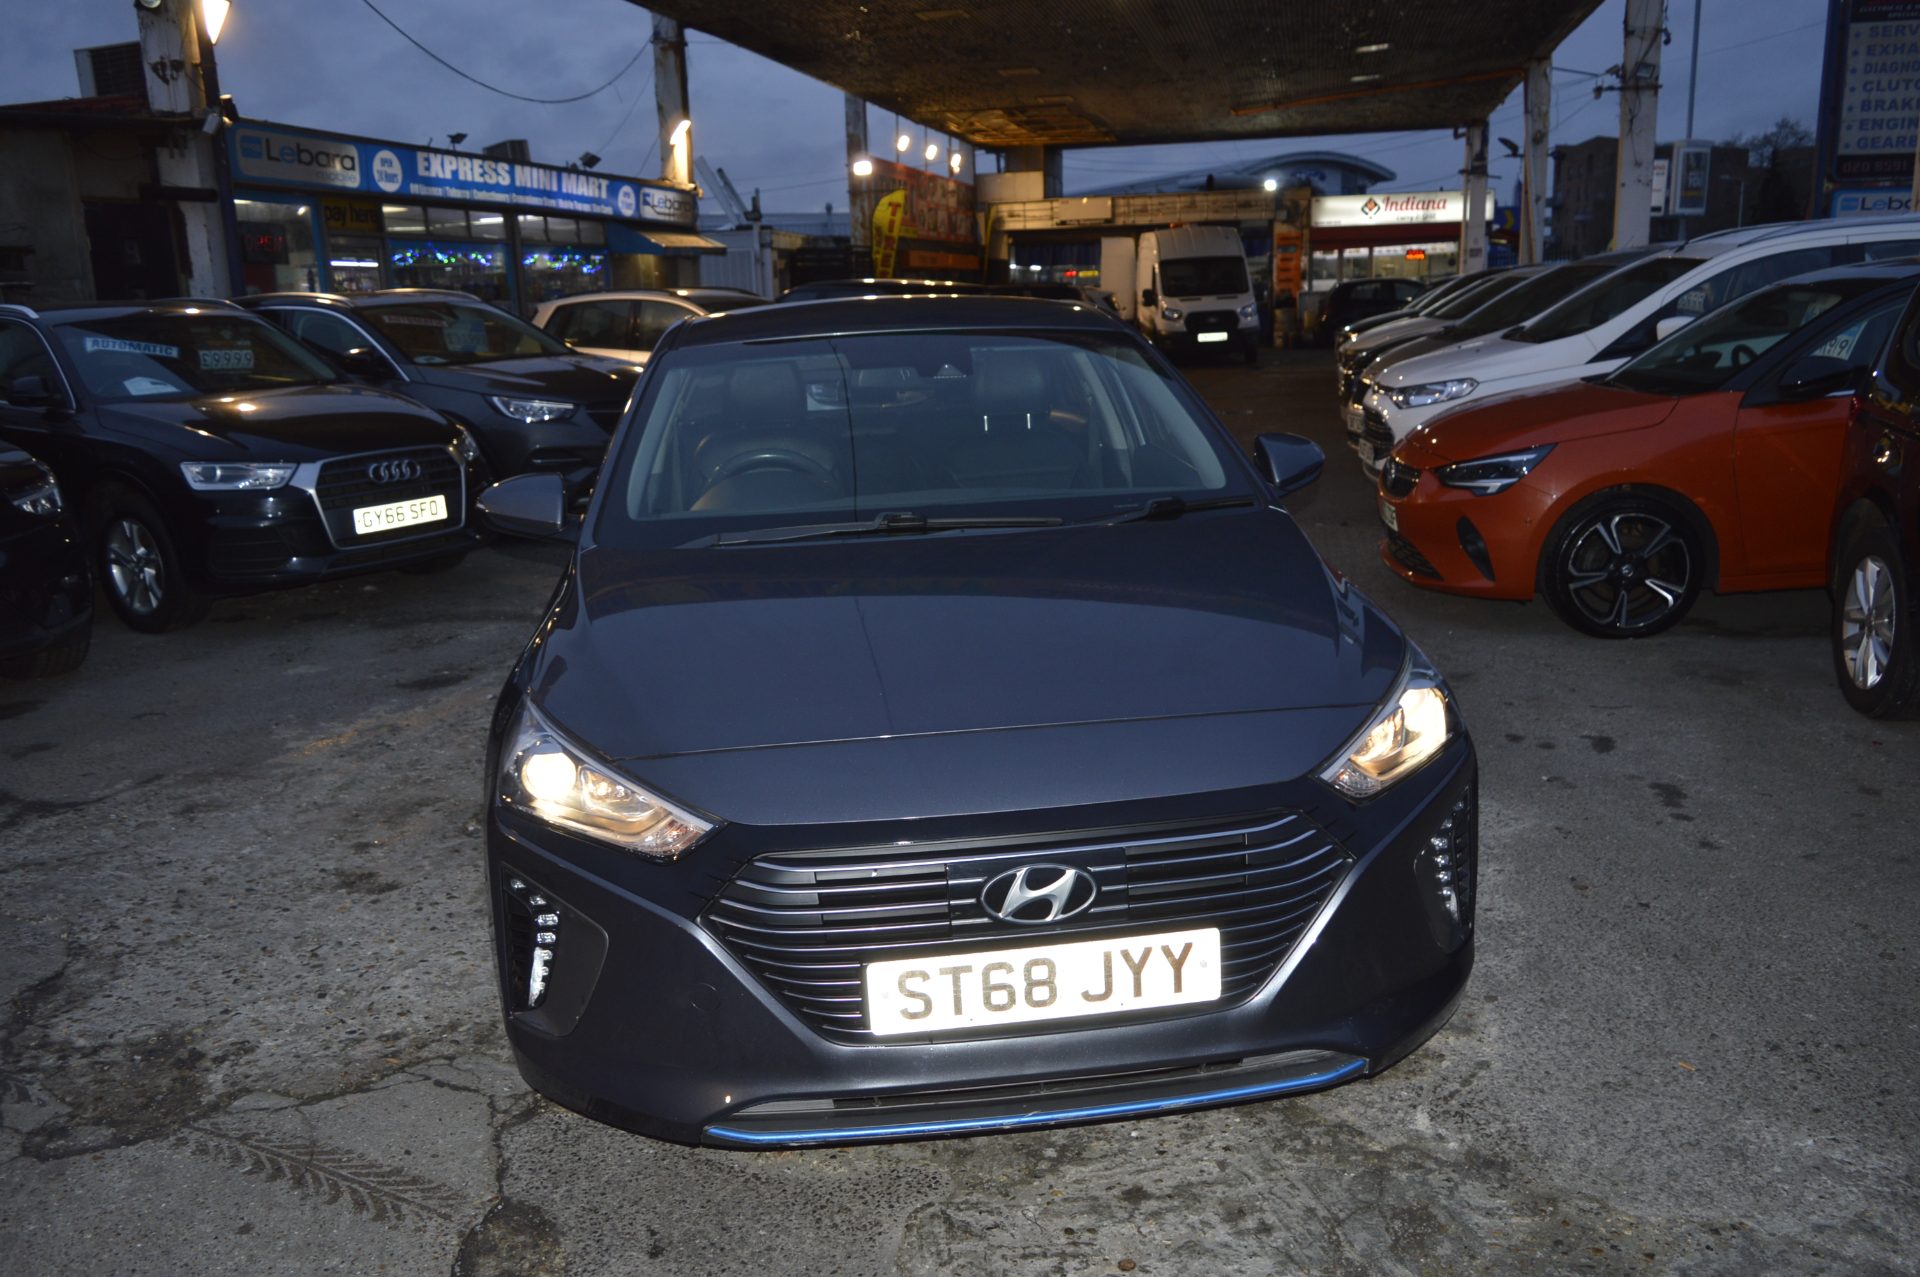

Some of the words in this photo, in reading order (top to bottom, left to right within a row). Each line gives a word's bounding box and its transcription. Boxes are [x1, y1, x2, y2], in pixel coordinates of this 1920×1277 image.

[264, 138, 356, 171] Lebara
[416, 151, 511, 187] EXPRESS
[513, 164, 558, 192] MINI
[561, 171, 610, 200] MART
[1383, 195, 1447, 212] Indiana
[90, 339, 173, 356] AUTOMATIC
[362, 506, 405, 528] GY66
[897, 957, 1058, 1020] ST68
[1081, 942, 1193, 1002] JYY
